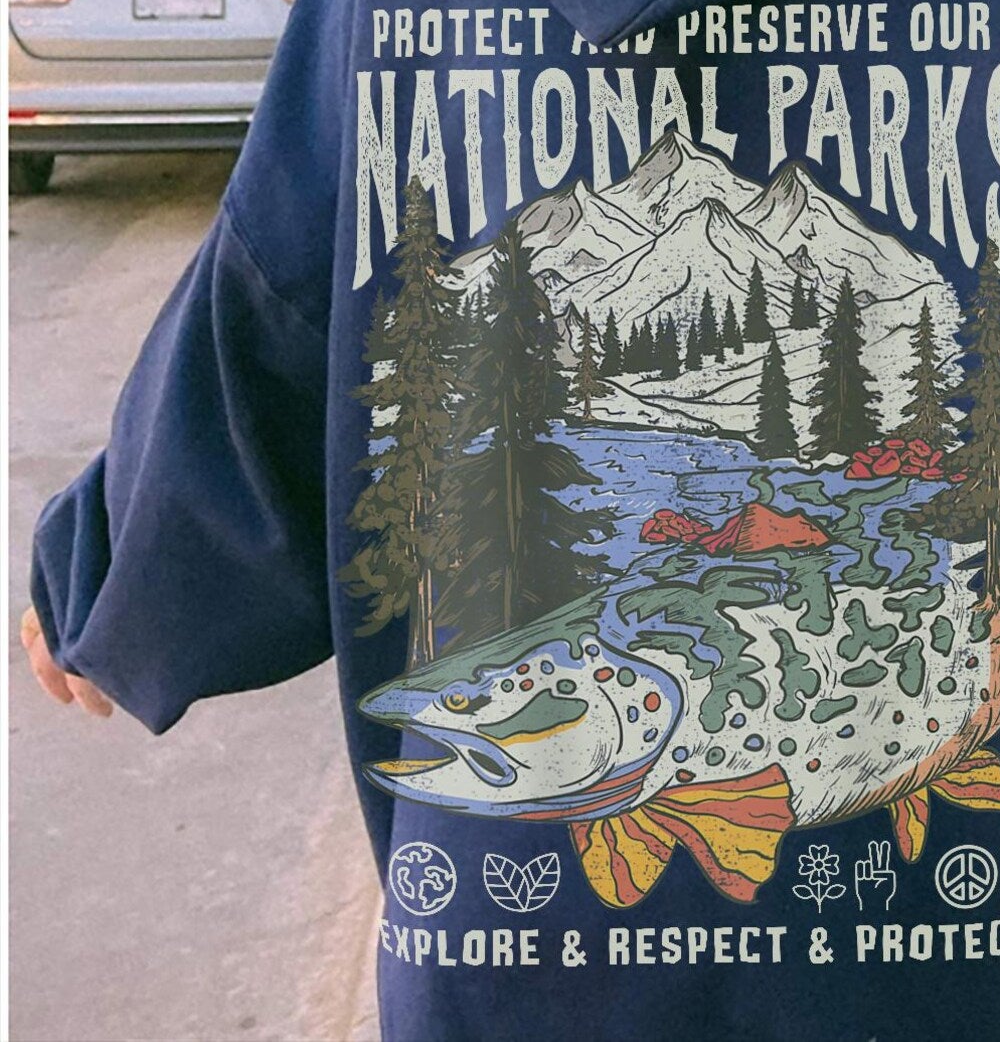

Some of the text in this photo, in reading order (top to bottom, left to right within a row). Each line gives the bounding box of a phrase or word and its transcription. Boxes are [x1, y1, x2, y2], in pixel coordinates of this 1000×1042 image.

[373, 2, 991, 58] PROTECT AD PRESERVE OUR
[352, 64, 739, 290] NATIONAL
[378, 919, 541, 967] EXPLORE
[562, 929, 587, 968] &
[608, 926, 787, 965] RESPECT
[808, 926, 834, 964] &
